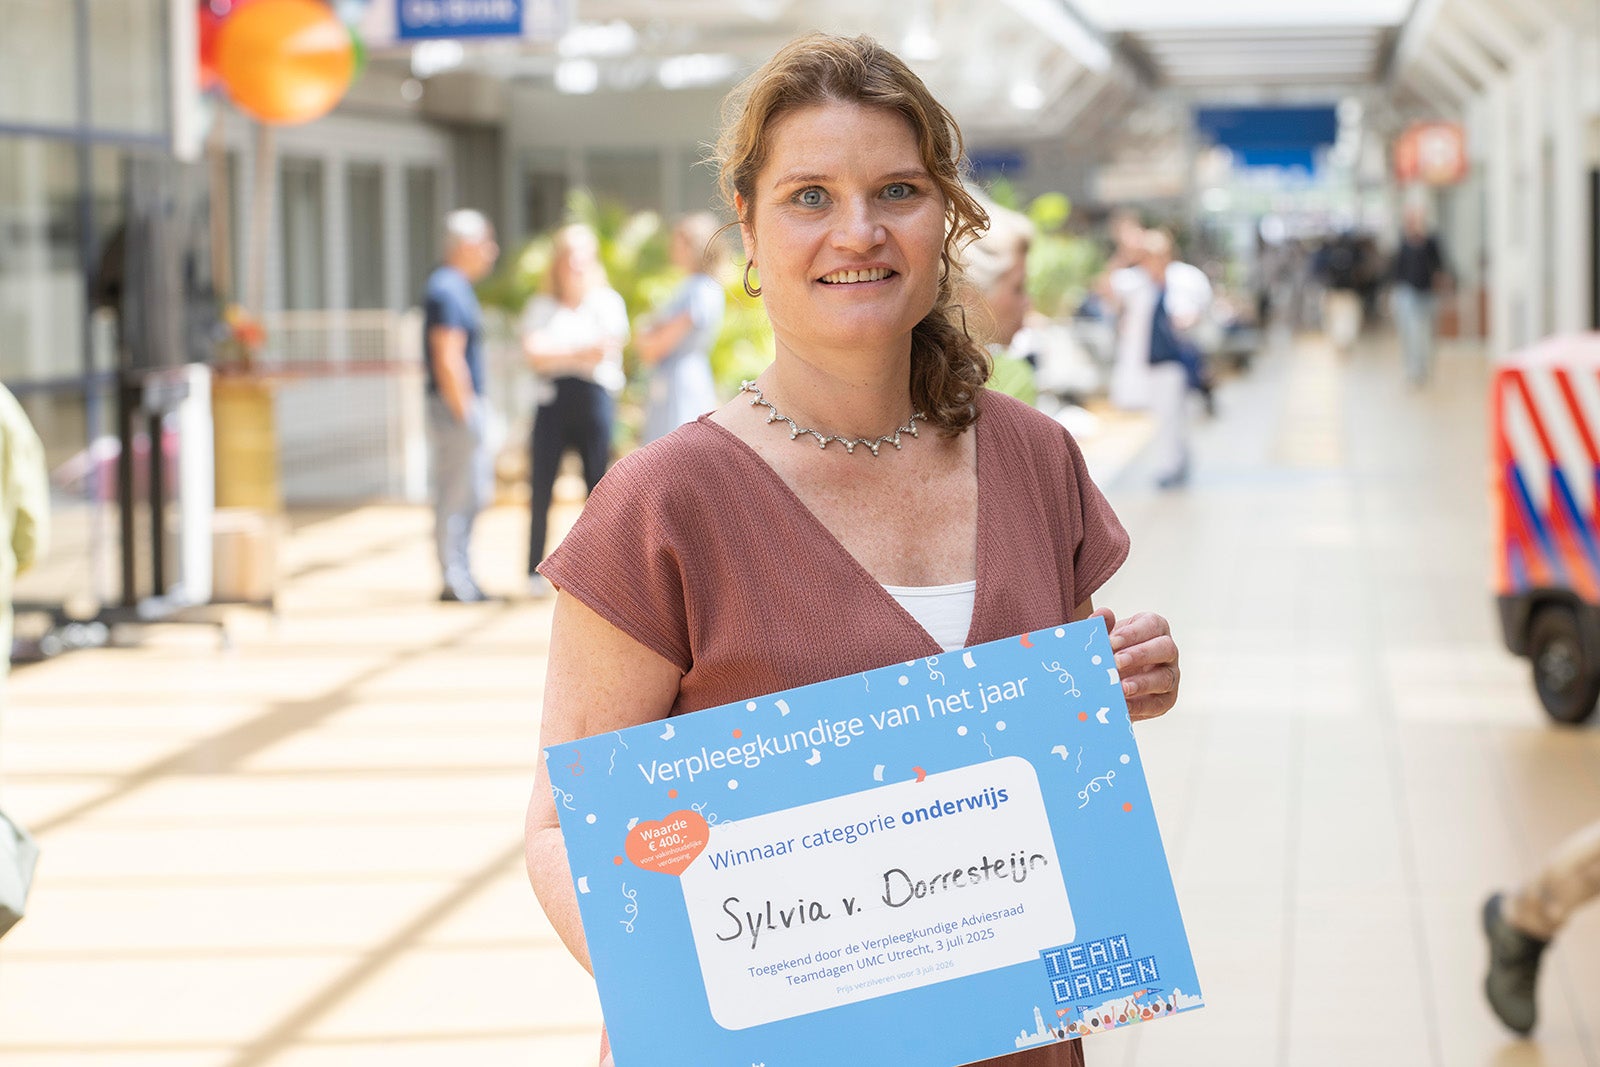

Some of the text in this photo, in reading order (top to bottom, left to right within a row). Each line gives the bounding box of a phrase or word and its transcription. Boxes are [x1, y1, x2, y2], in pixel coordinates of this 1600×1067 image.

[638, 677, 1029, 785] Verpleegkundige van het jaar
[640, 819, 688, 842] Waarde
[648, 833, 688, 852] € 400,-
[708, 786, 1009, 870] Winnaar categorie onderwijs
[716, 850, 1048, 949] Sylvia v. Dorresteijn
[748, 903, 1025, 978] Toegekend door de Verpleegkundige Adviesraad
[785, 928, 995, 986] Teamdagen UMC Utrecht, 3 juli 2025
[1045, 936, 1131, 975] TEAM
[896, 971, 914, 981] voor
[915, 967, 921, 976] 3
[921, 964, 935, 975] juli
[935, 959, 955, 971] 2026
[1052, 957, 1158, 1003] DAGEN
